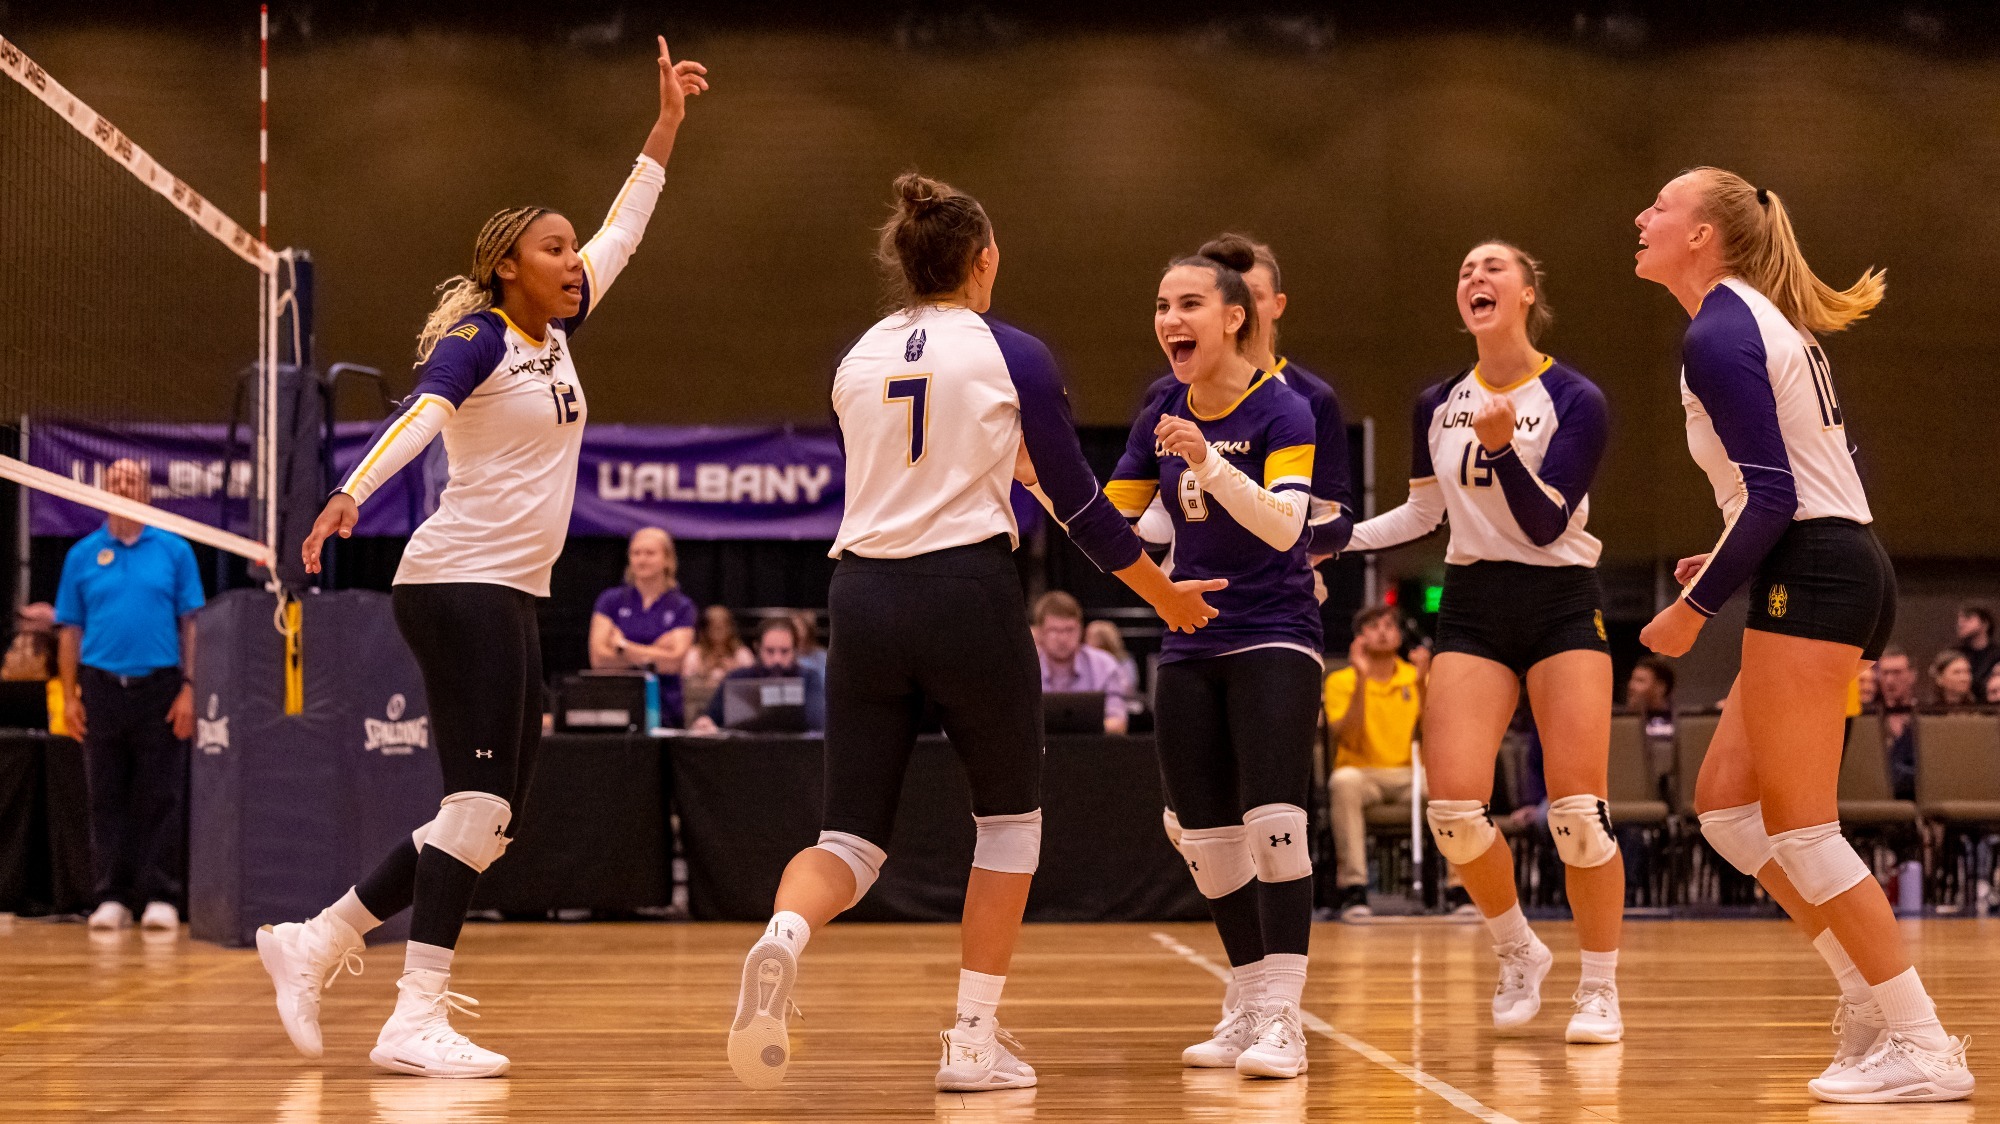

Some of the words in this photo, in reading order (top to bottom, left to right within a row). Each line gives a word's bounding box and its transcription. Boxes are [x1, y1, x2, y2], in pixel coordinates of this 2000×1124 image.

[550, 381, 582, 427] 12
[1803, 341, 1844, 430] 10
[883, 373, 933, 468] 7
[1442, 411, 1541, 432] UALNY
[598, 461, 831, 503] UALBANY
[1458, 440, 1494, 488] 15
[1178, 468, 1209, 522] 8
[364, 713, 428, 752] SPALDING
